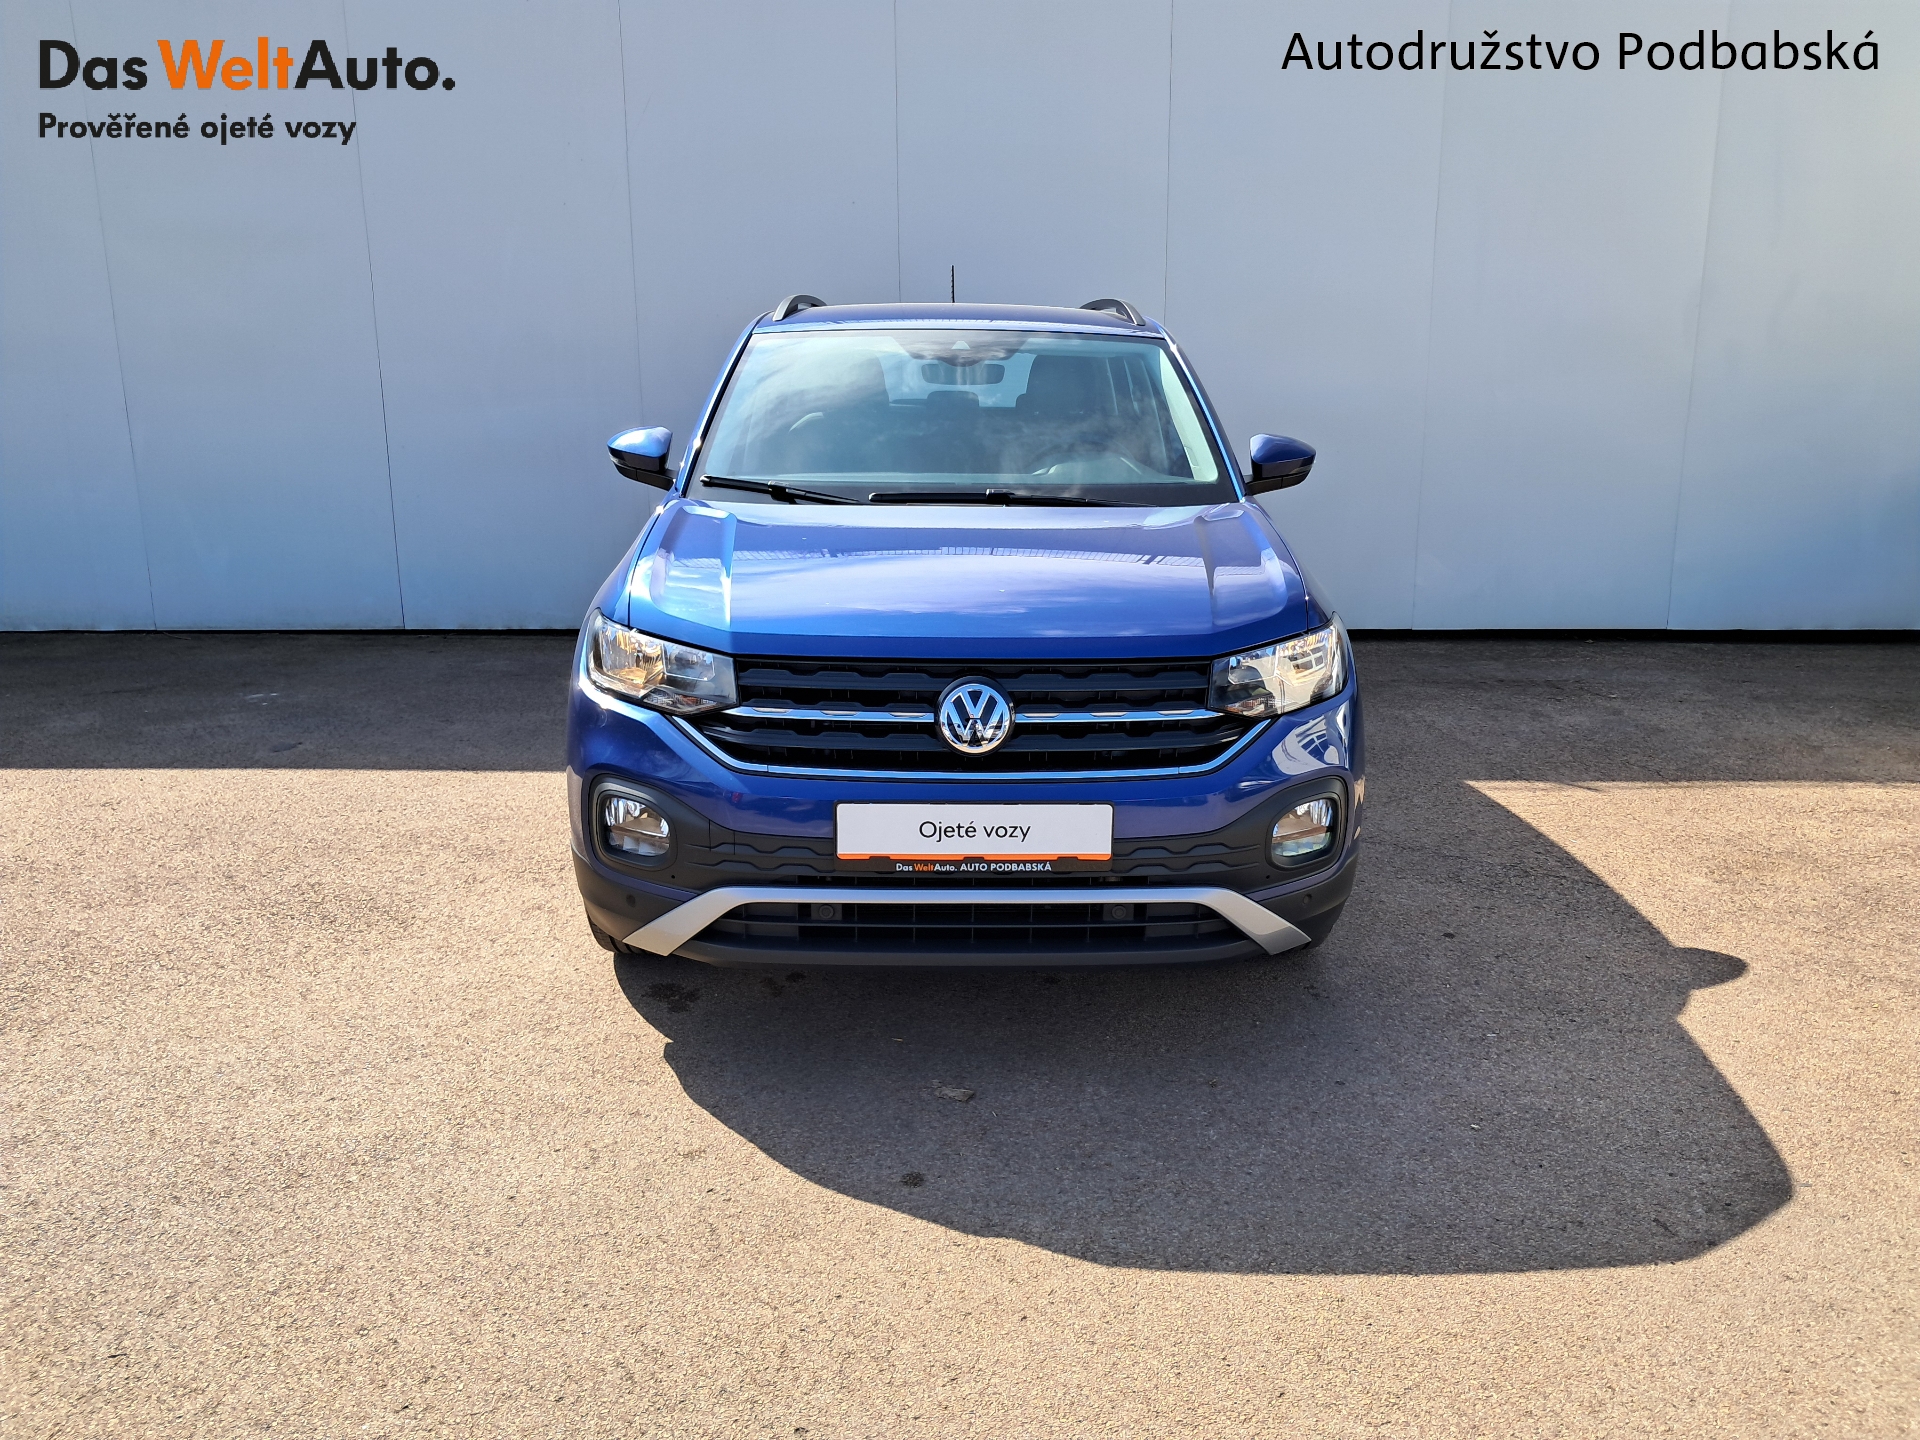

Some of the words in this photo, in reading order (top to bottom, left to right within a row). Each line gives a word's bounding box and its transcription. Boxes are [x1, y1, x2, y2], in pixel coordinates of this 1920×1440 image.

[919, 820, 977, 843] Ojeté
[982, 825, 1031, 843] vozy
[895, 862, 913, 872] Das
[914, 862, 958, 872] WeltAuto.
[959, 862, 988, 872] AUTO
[990, 859, 1052, 872] PODBABSKÁ
